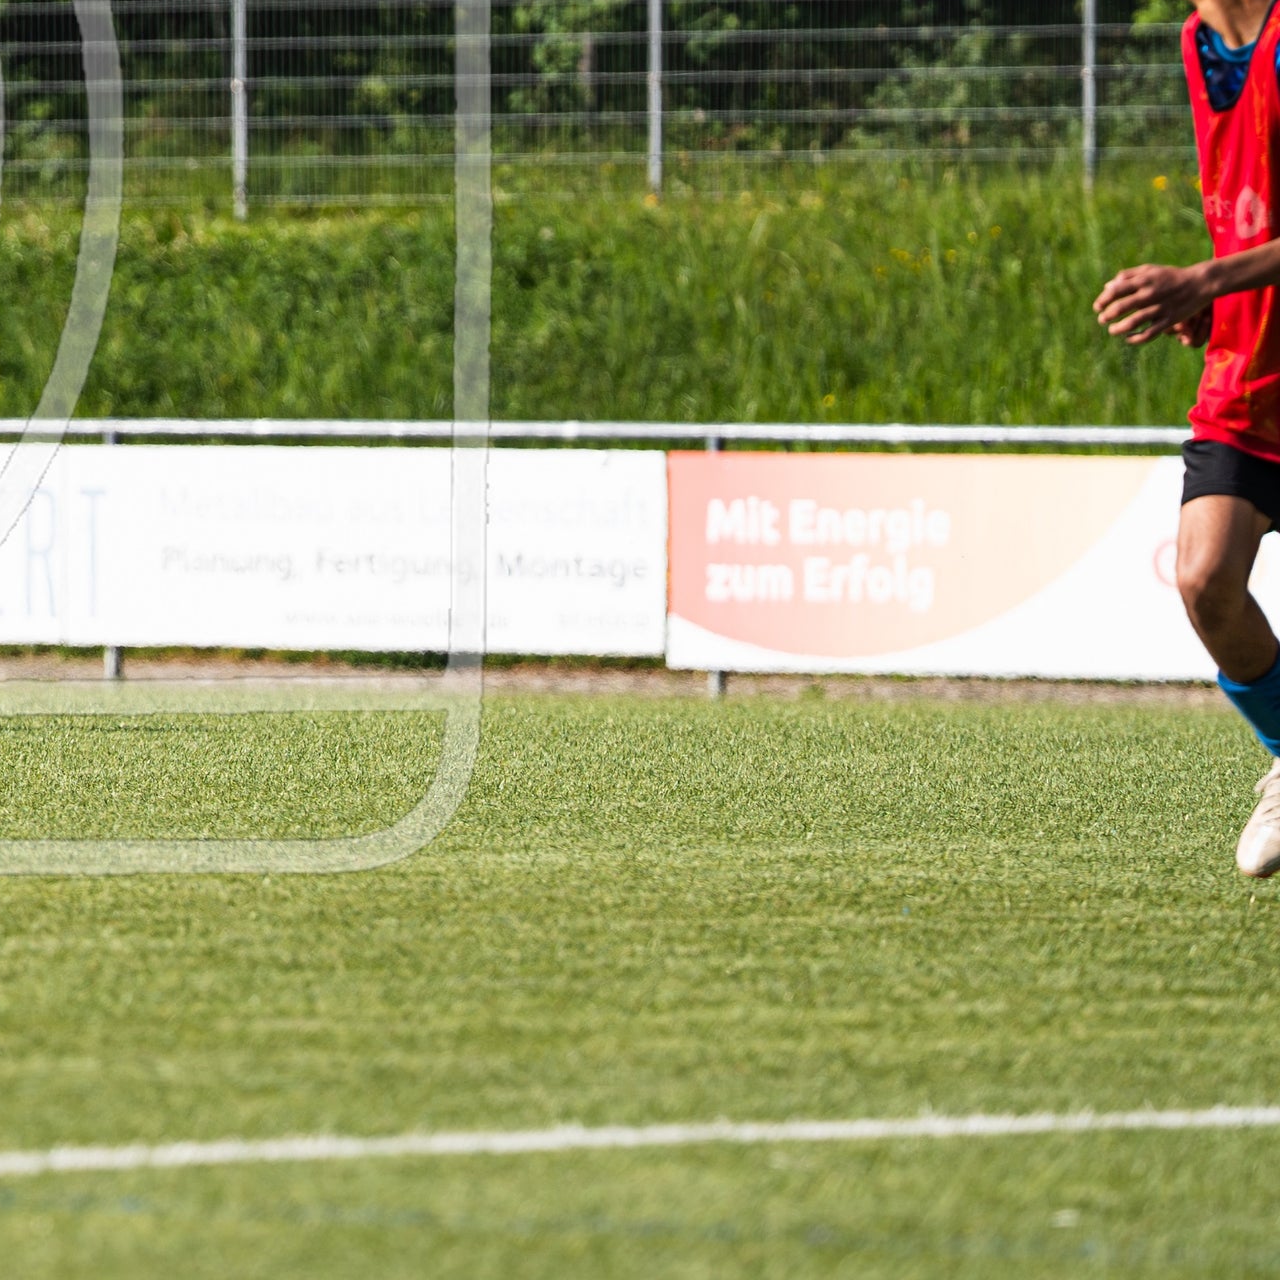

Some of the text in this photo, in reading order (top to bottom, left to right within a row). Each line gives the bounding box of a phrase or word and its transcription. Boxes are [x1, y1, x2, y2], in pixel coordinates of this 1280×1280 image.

[706, 497, 952, 555] Mit Energie
[495, 548, 649, 589] Montage
[706, 553, 934, 613] zum Erfolg
